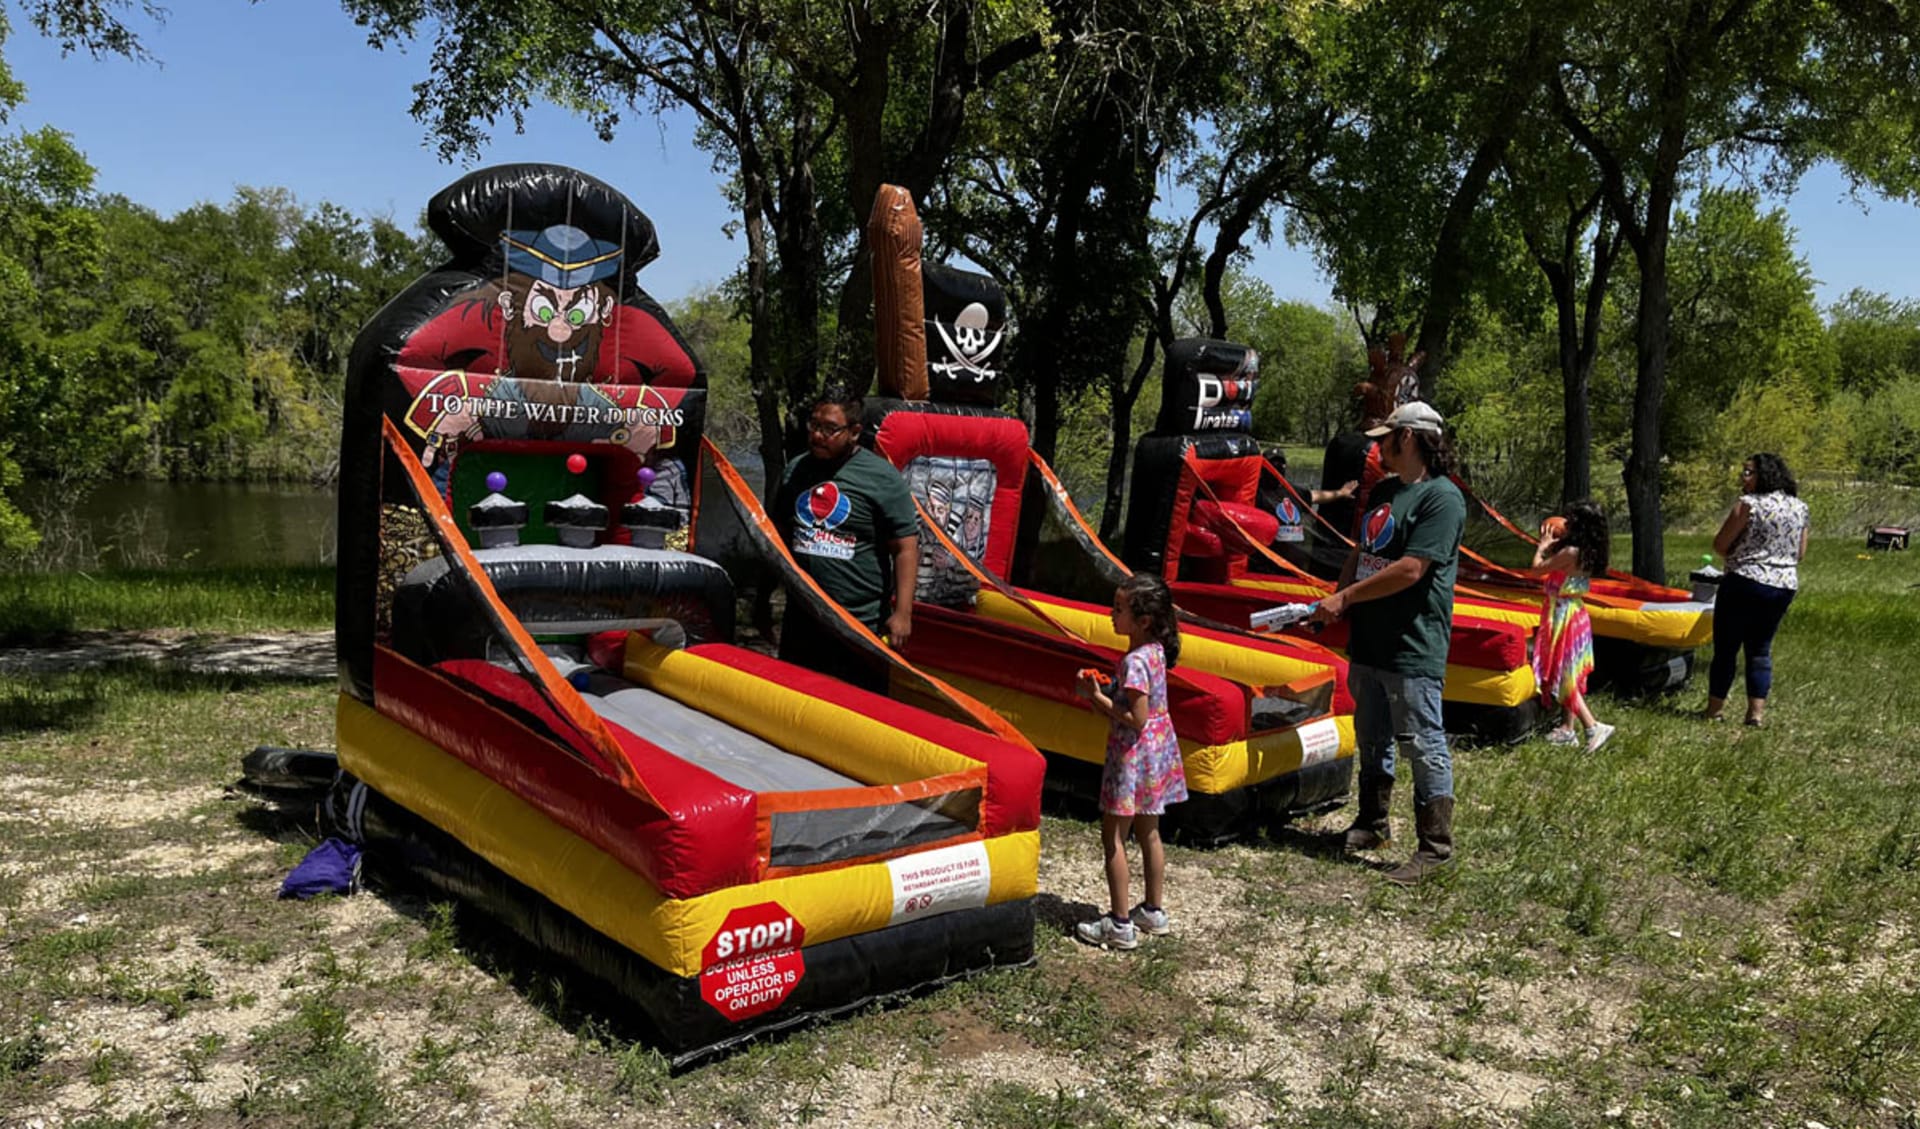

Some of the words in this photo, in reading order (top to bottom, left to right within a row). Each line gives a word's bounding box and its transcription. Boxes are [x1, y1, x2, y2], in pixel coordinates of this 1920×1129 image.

[426, 393, 462, 415] TO
[468, 397, 519, 419] THE
[523, 402, 601, 424] WATER
[607, 406, 685, 428] DUCKS
[901, 872, 919, 882] THIS
[920, 864, 956, 877] PRODUCT
[956, 861, 964, 870] IS
[964, 858, 980, 868] FIRE
[903, 879, 938, 892] RETARDANT
[940, 875, 951, 883] AND
[716, 917, 793, 958] STOP!
[705, 963, 725, 976] DO
[726, 955, 753, 970] NOT
[754, 946, 796, 963] ENTER
[726, 961, 776, 984] UNLESS
[714, 973, 782, 1001] OPERATOR
[783, 970, 796, 983] IS
[729, 997, 748, 1010] ON
[751, 987, 784, 1005] DUTY
